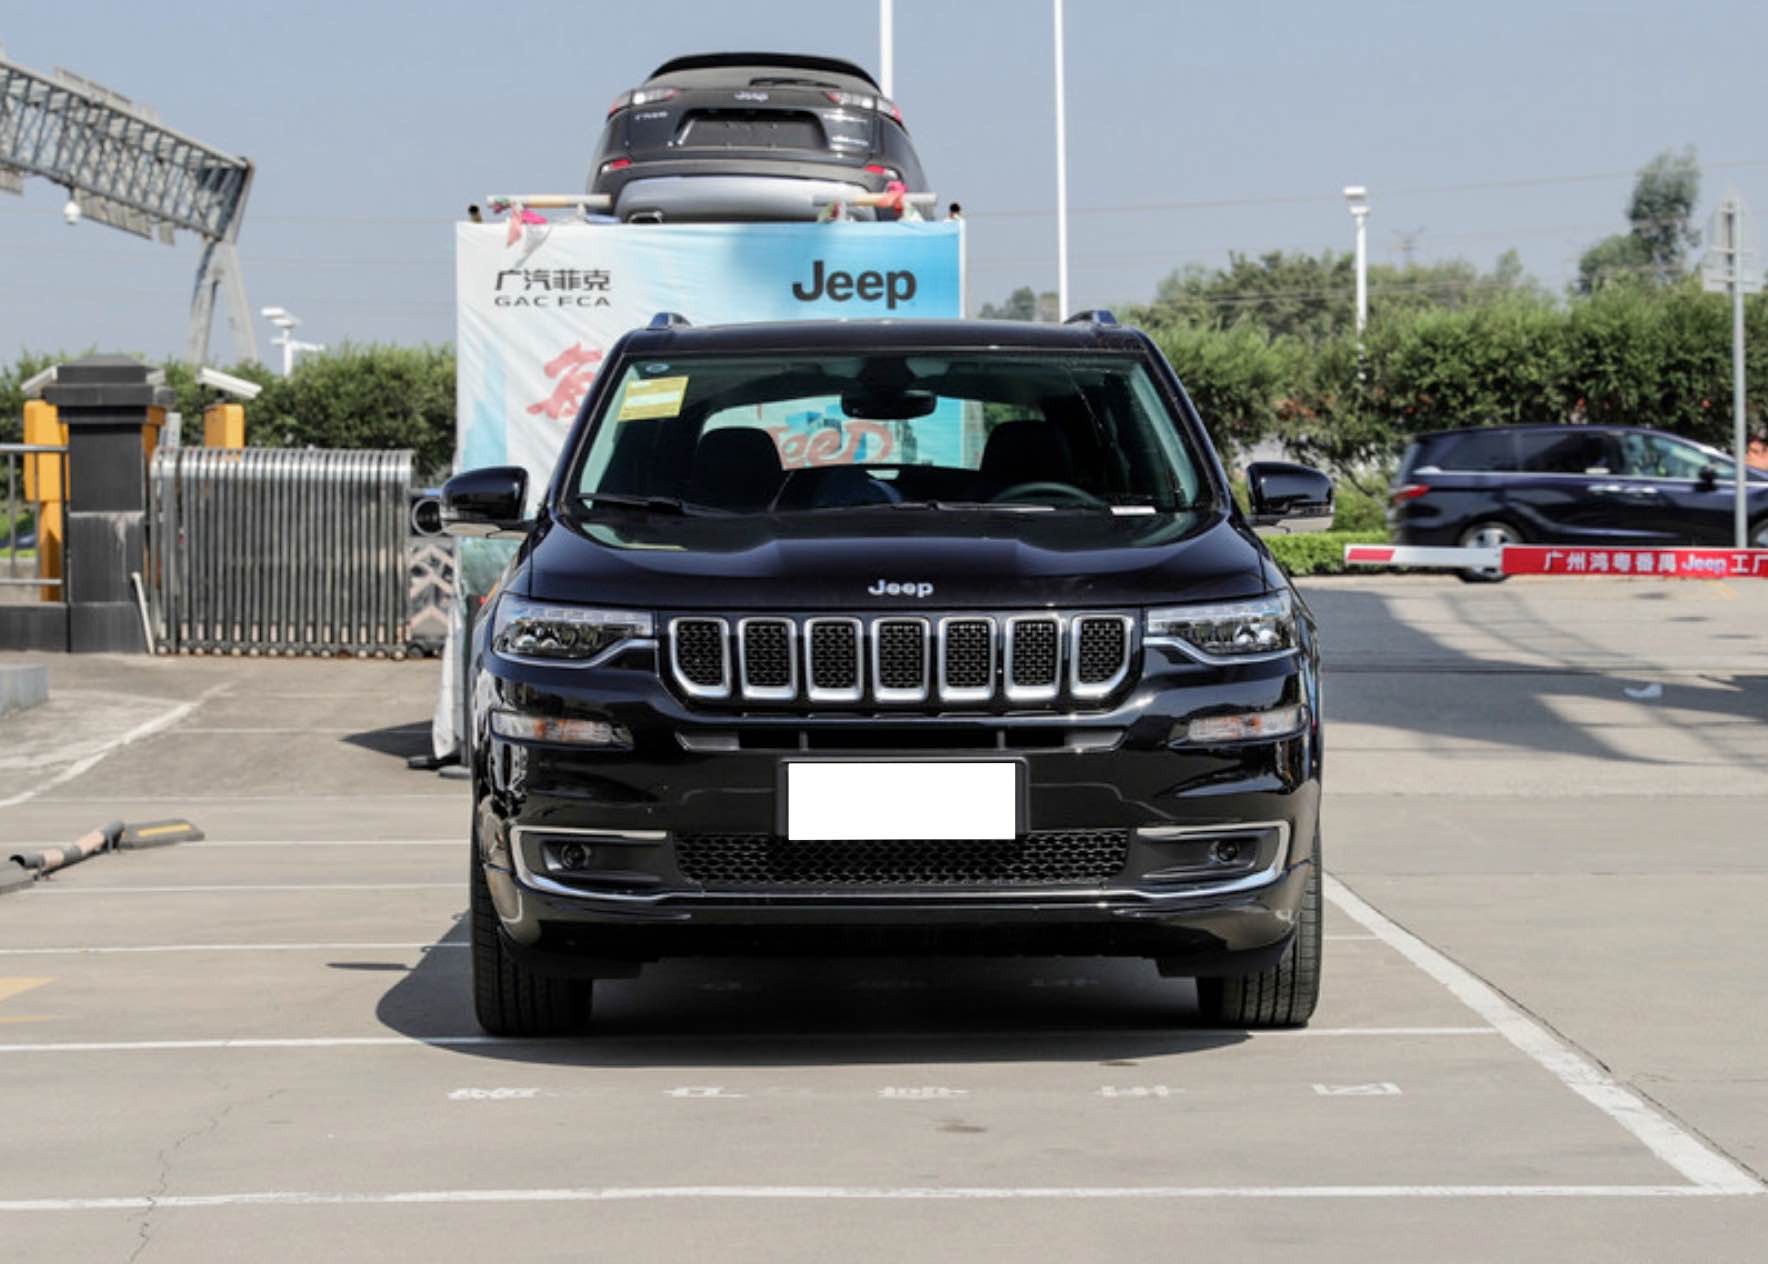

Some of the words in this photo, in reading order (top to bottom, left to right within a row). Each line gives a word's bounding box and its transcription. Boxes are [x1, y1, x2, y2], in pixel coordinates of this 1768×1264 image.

[495, 269, 611, 292] 广汽菲克
[793, 261, 917, 309] Jeep
[495, 296, 549, 306] GAC
[559, 296, 611, 306] FCA
[1682, 554, 1727, 574] Jeep
[867, 579, 934, 599] Jeep
